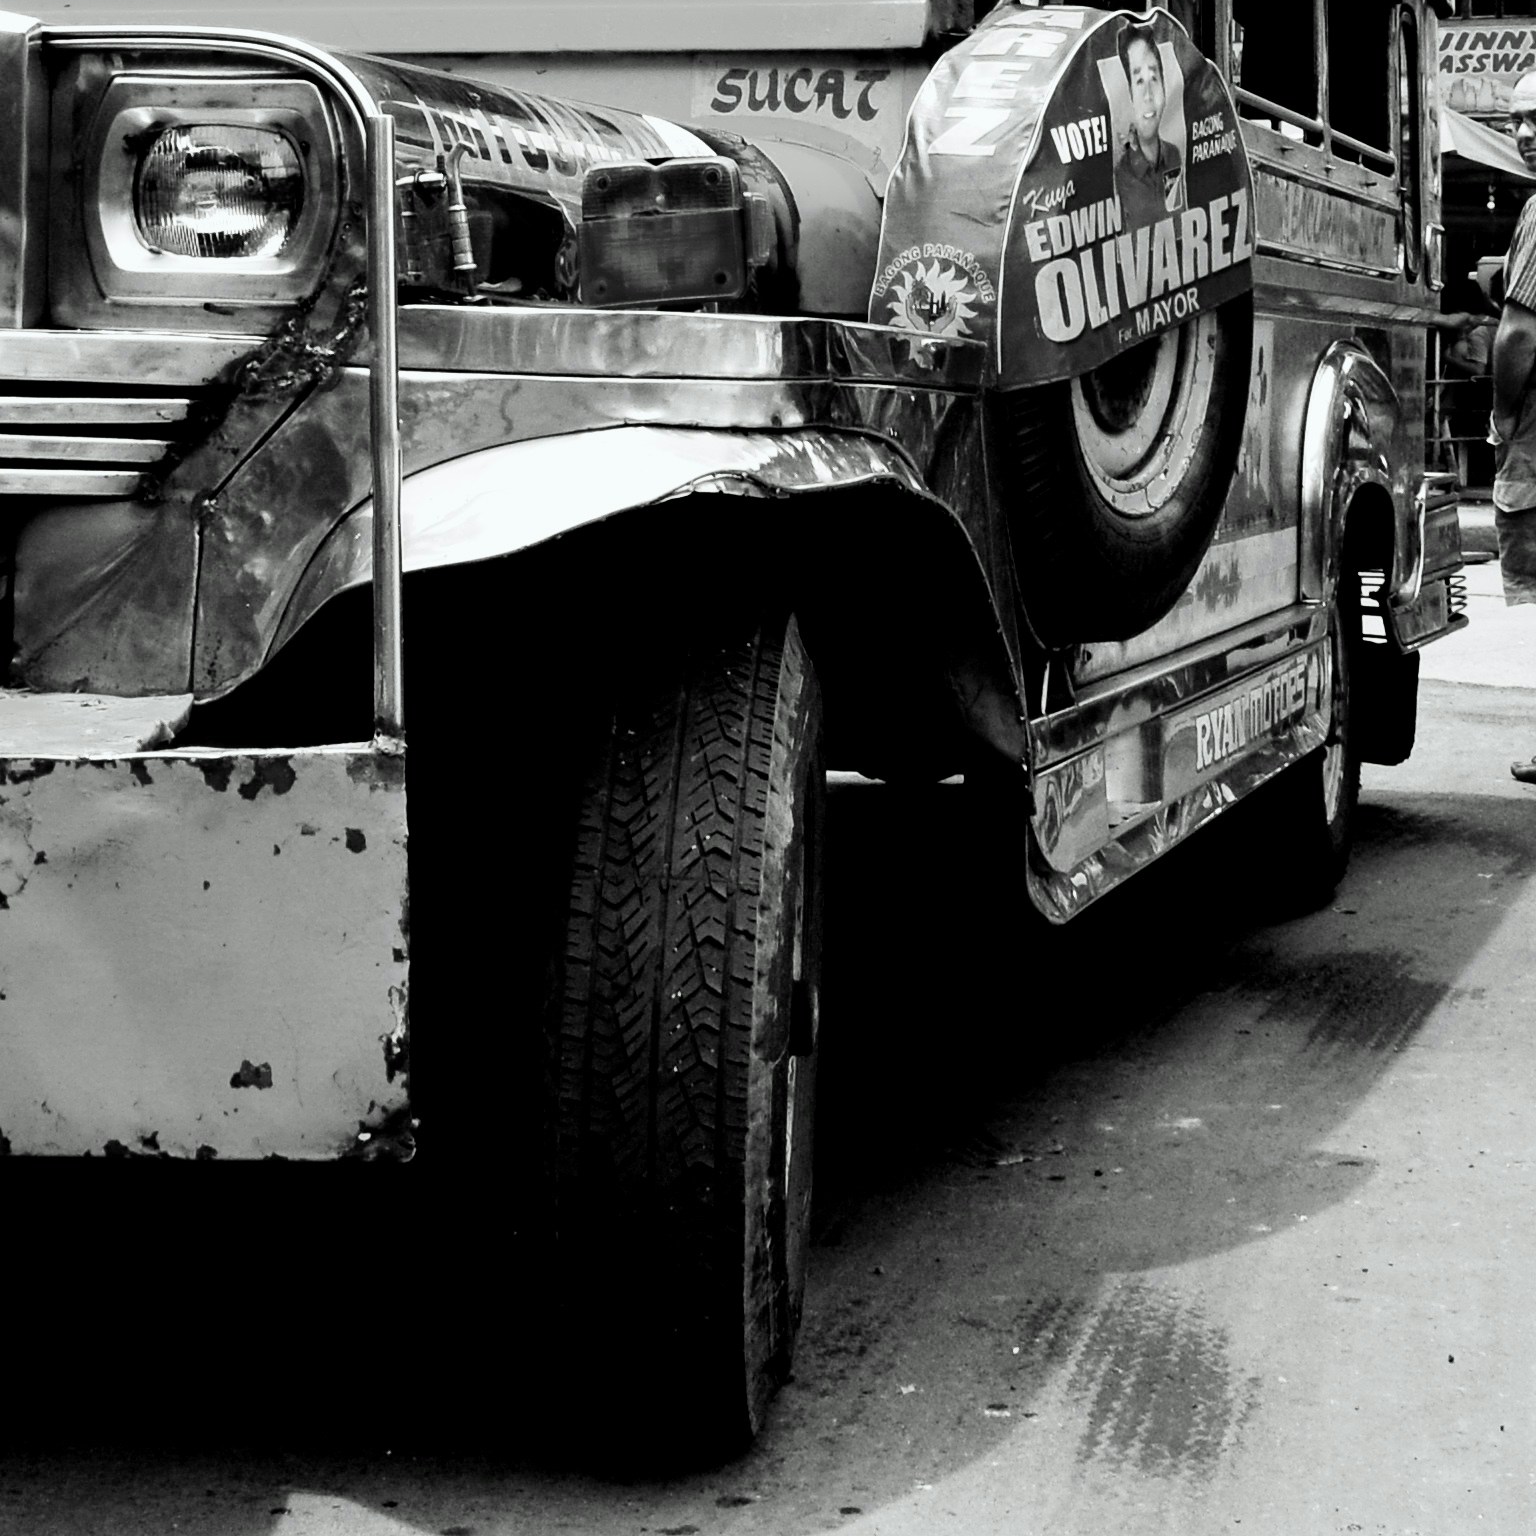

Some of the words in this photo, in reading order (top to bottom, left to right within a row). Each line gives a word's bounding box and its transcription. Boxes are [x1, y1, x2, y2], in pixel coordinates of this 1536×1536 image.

[710, 67, 891, 122] SUCAT
[927, 10, 1085, 156] AREZ
[1050, 115, 1108, 164] VOTE!
[1192, 112, 1224, 141] BAGONG
[1022, 178, 1077, 218] Kuya
[1024, 195, 1123, 263] EDWIN
[873, 245, 922, 297] BAGONG
[1034, 187, 1253, 343] OLIVAREZ
[1135, 287, 1200, 337] MAYOR
[1195, 695, 1249, 772] RYAN
